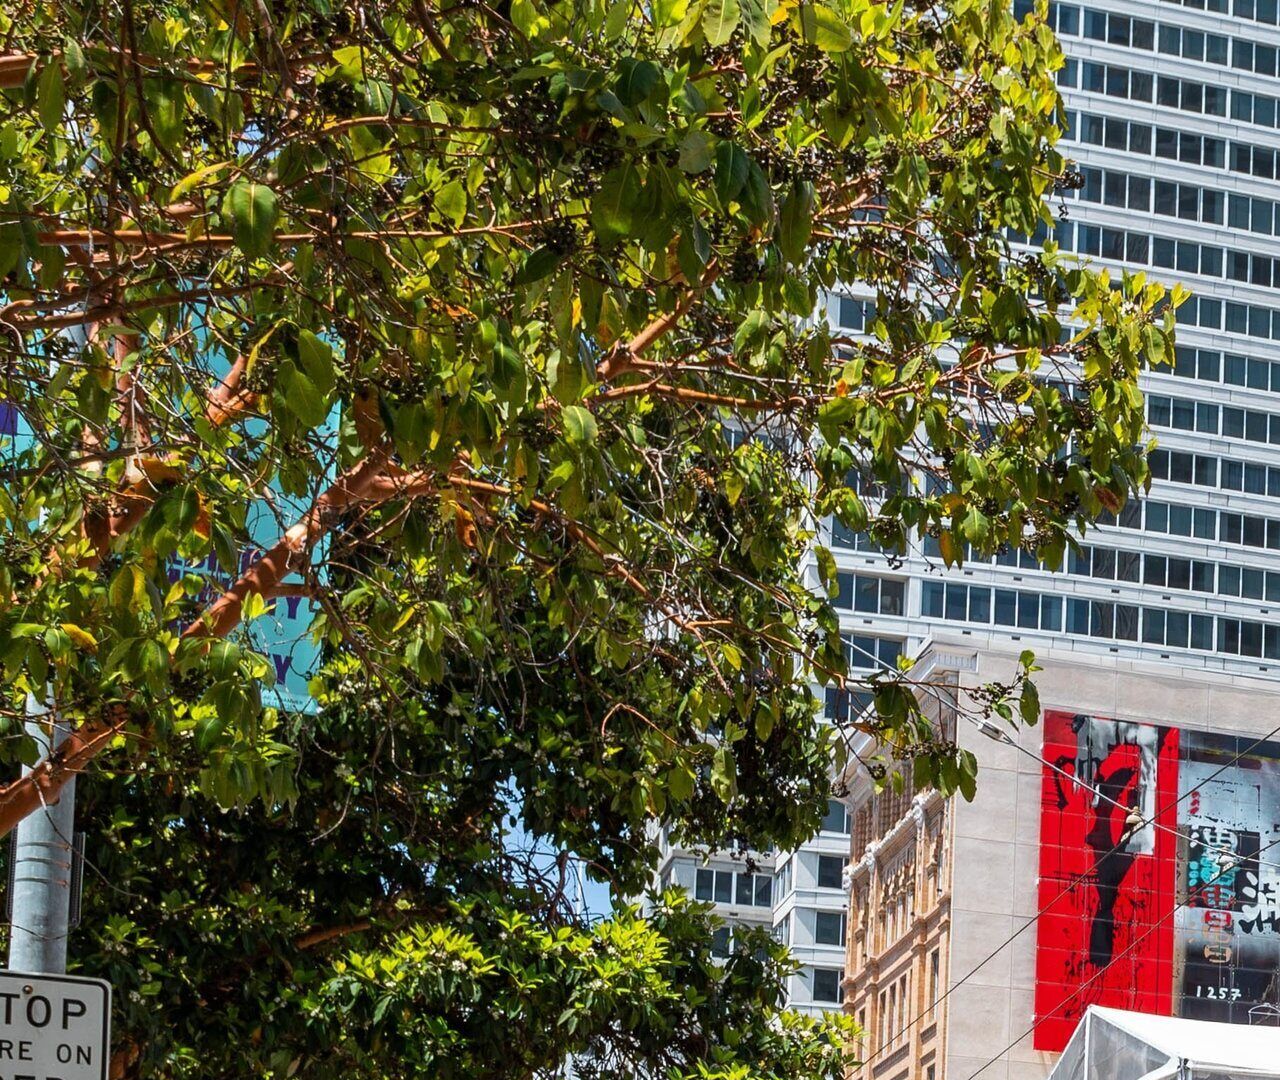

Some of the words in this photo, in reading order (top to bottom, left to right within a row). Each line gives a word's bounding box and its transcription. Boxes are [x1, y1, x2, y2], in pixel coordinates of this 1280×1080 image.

[1197, 985, 1242, 999] 1257
[0, 992, 87, 1030] TOP
[56, 1044, 92, 1065] ON
